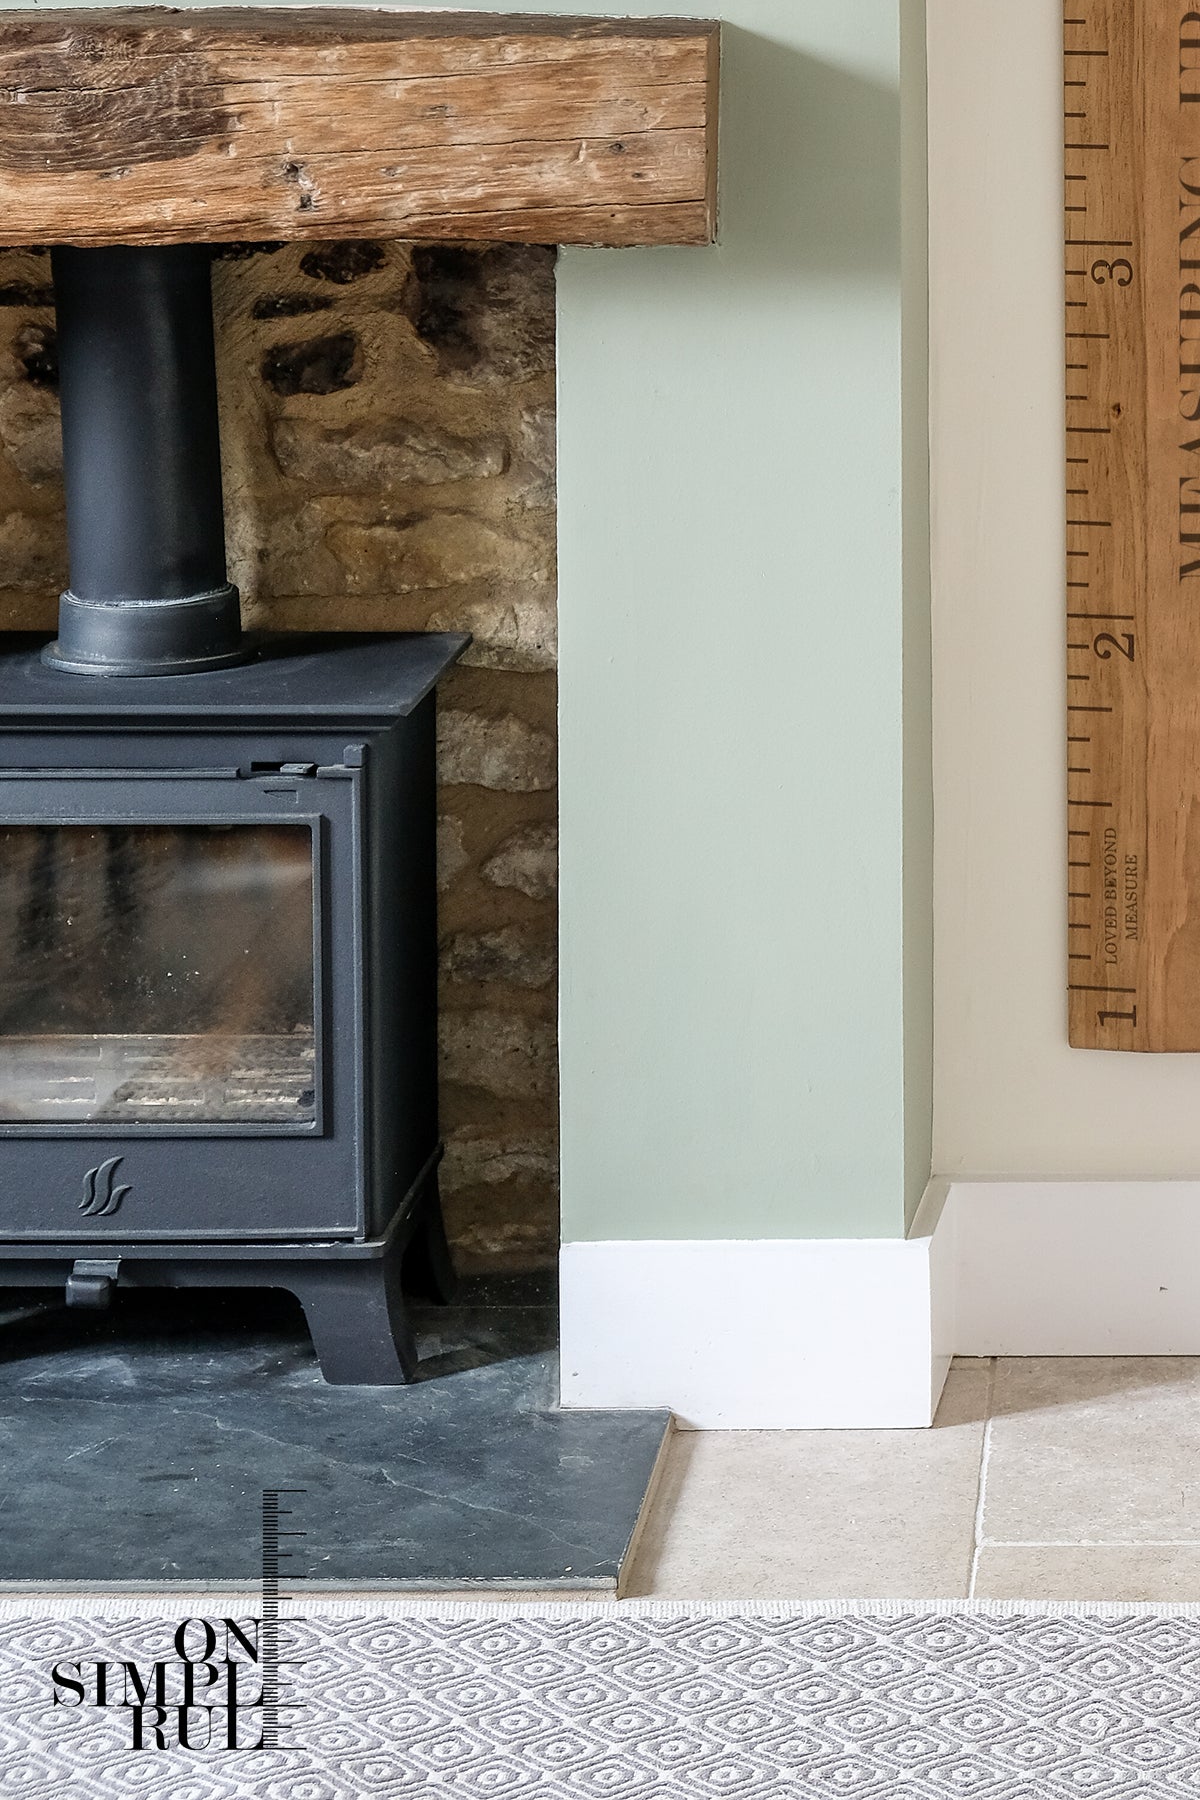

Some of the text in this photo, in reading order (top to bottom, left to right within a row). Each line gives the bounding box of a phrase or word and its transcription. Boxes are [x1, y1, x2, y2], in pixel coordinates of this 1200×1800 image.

[1091, 259, 1133, 287] 3
[1094, 632, 1134, 662] 2
[1105, 828, 1117, 965] LOVED BEYOND
[1125, 854, 1137, 940] MEASURE
[1097, 1005, 1136, 1027] 1
